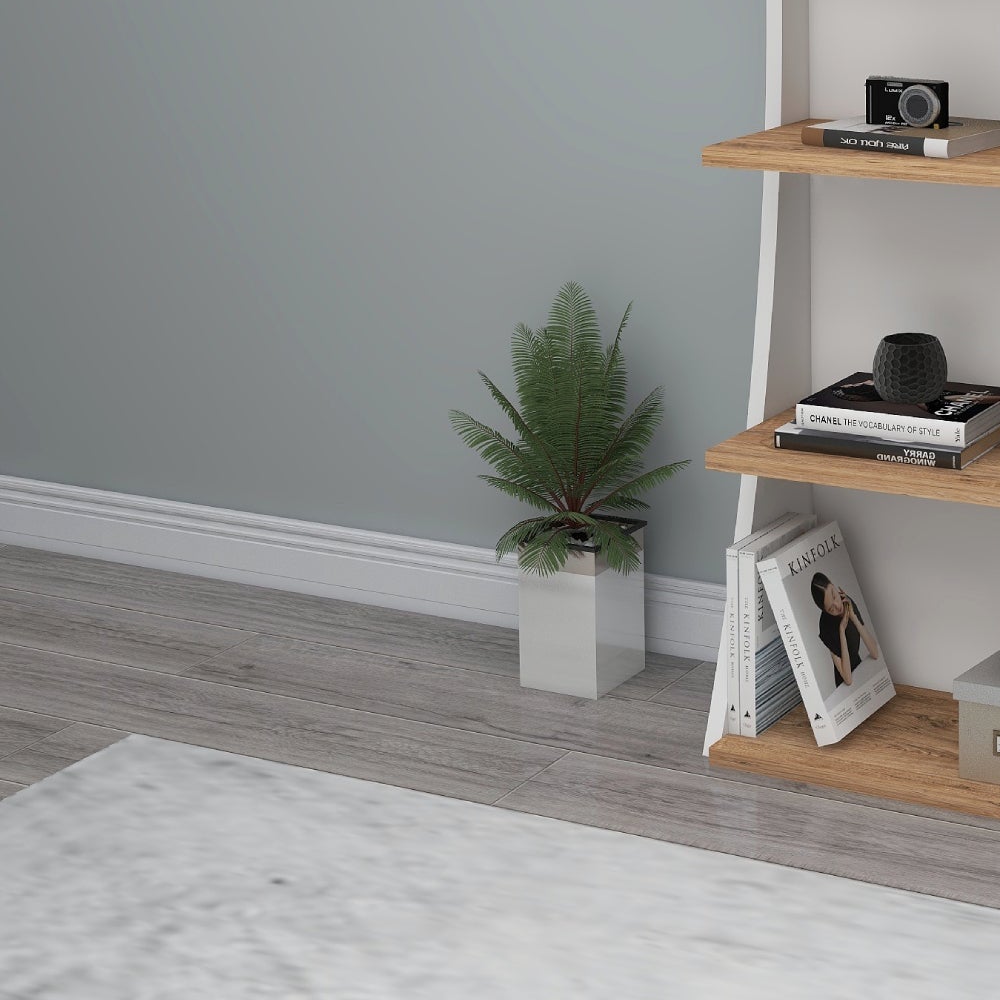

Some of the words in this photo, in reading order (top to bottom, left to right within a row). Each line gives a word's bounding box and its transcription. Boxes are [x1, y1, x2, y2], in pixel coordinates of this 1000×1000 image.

[840, 137, 858, 145] OK
[934, 389, 990, 417] CHANEL
[809, 414, 842, 426] CHANEL
[843, 418, 857, 428] THE
[857, 420, 906, 433] VOCABULARY
[906, 425, 917, 434] OF
[918, 427, 941, 437] STYLE
[788, 534, 841, 577] KINFOLK
[743, 613, 751, 662] KINFOLK
[783, 623, 804, 669] KINFOLK
